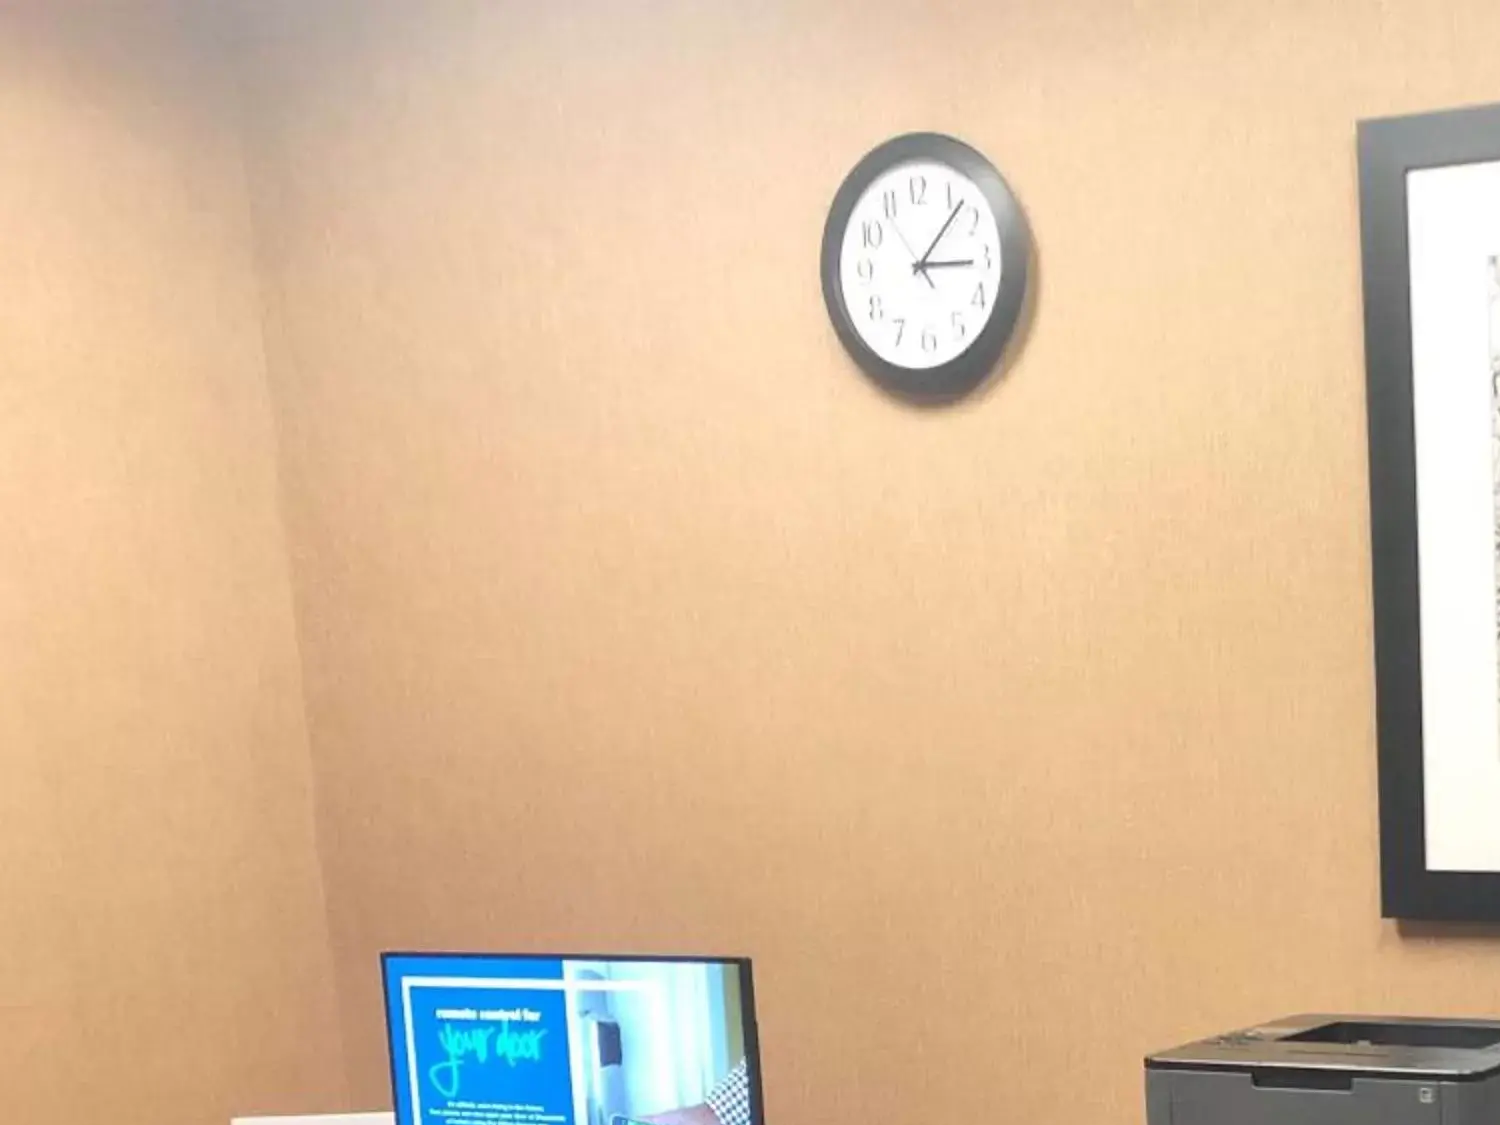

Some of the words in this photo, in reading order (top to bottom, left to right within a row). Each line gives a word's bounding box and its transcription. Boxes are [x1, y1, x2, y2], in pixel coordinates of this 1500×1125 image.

[883, 189, 897, 219] 11
[909, 175, 927, 205] 12
[946, 181, 953, 210] 1
[861, 219, 883, 249] 10
[967, 206, 980, 237] 2
[983, 244, 992, 270] 3
[856, 258, 874, 286] 9
[868, 295, 884, 321] 8
[970, 281, 986, 310] 4
[892, 318, 905, 347] 7
[920, 328, 938, 352] 6
[951, 311, 966, 341] 5
